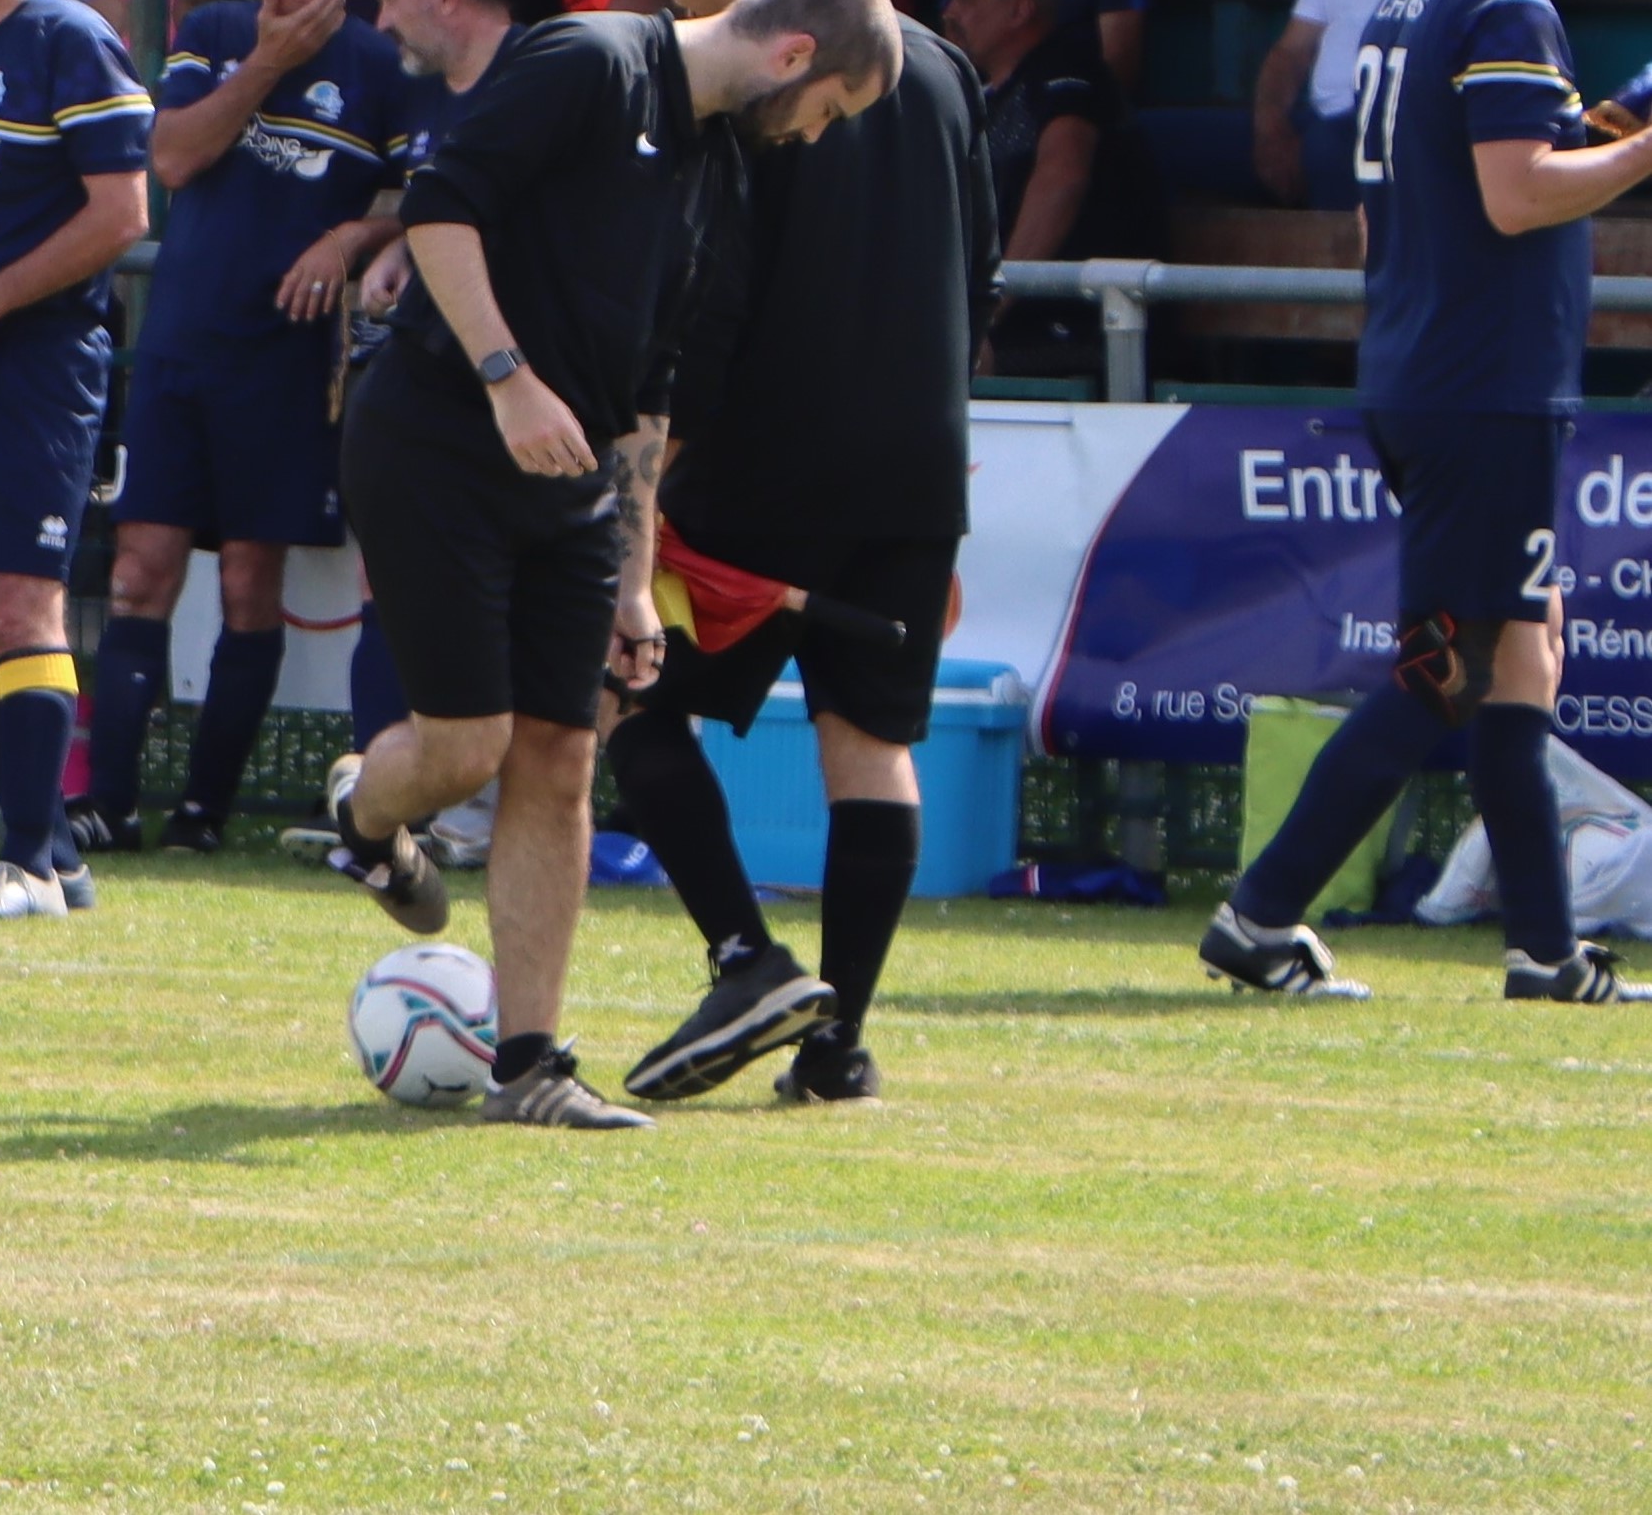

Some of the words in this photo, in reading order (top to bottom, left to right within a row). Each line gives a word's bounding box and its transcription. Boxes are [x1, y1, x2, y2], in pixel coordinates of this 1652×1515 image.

[1354, 44, 1408, 183] 21
[1241, 448, 1403, 522] Entr
[1152, 690, 1206, 721] rue
